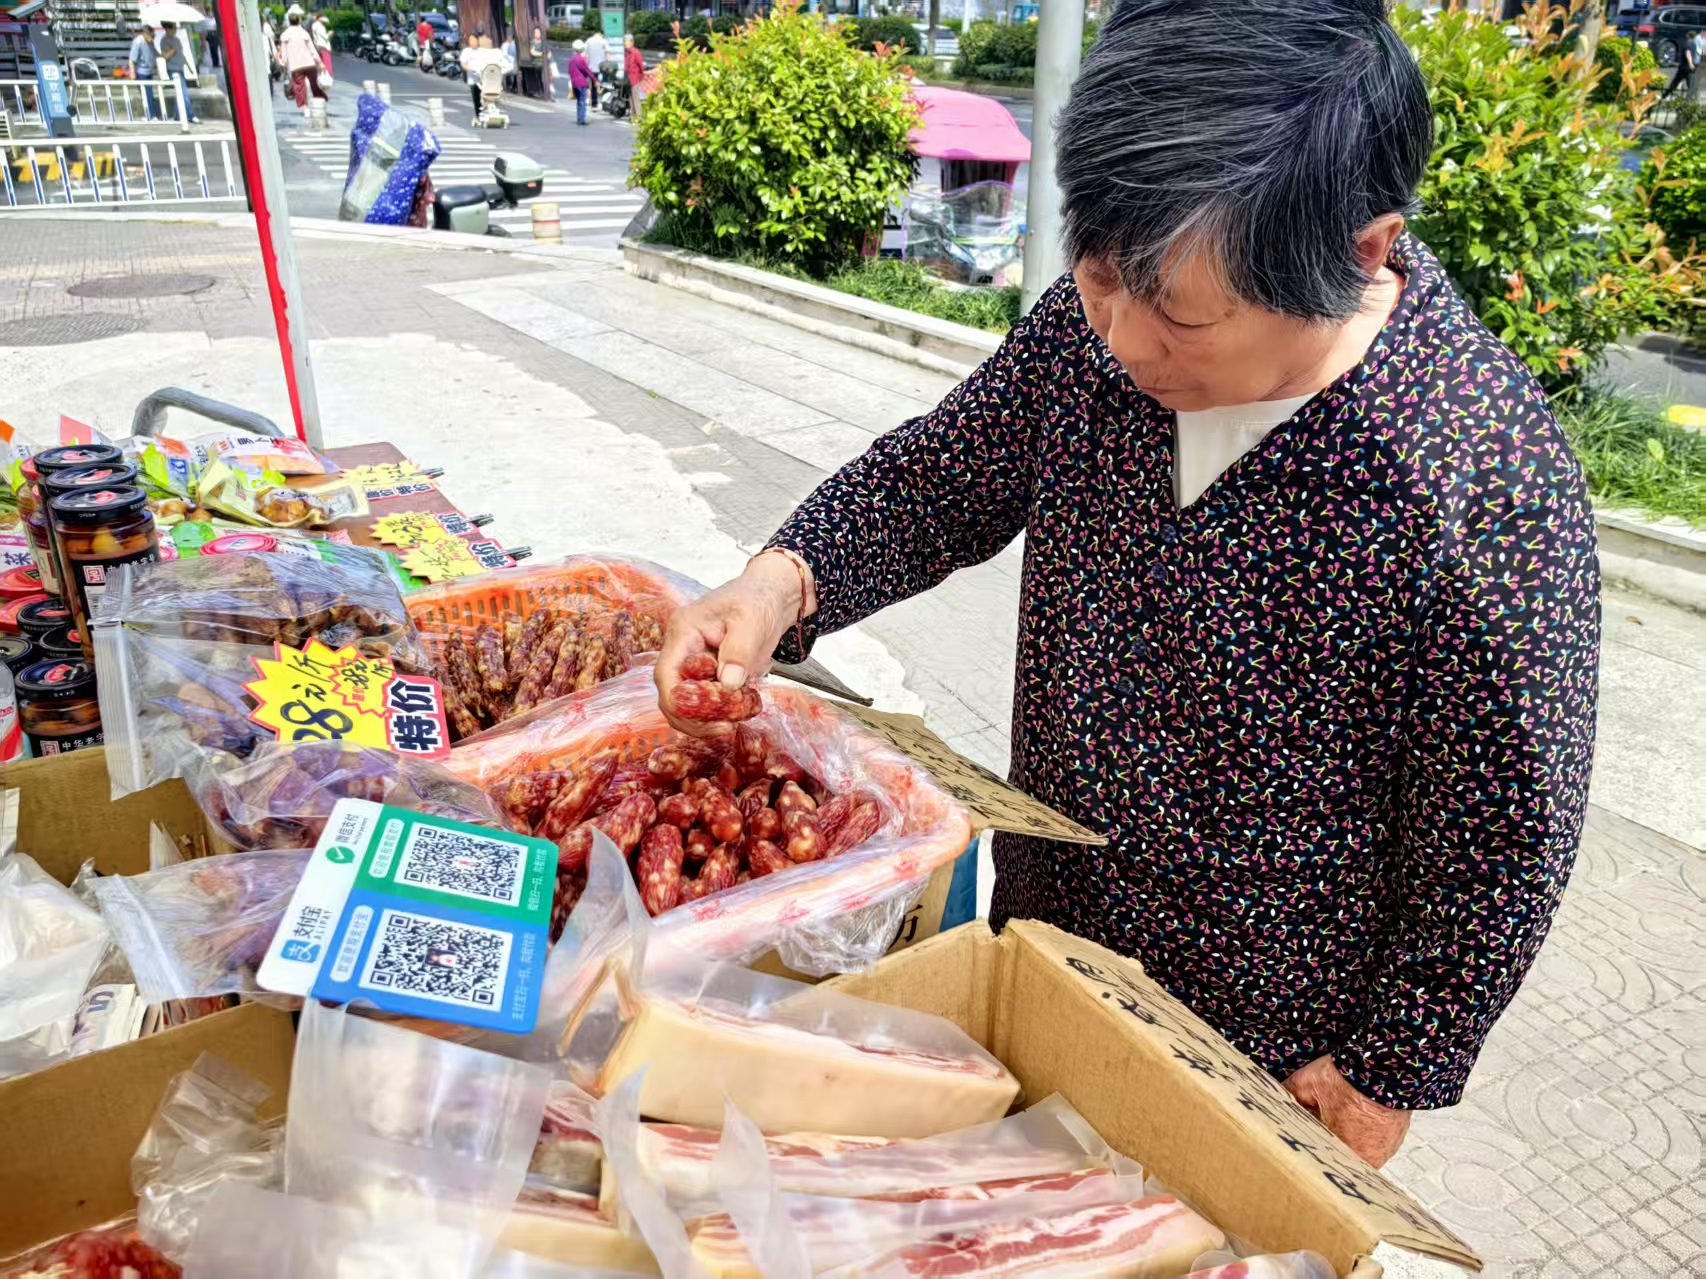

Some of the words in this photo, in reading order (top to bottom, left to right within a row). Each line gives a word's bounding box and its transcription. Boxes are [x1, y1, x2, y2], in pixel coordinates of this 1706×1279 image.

[472, 542, 509, 568] 特价
[390, 680, 439, 751] 特价
[336, 813, 361, 844] 微信支付
[294, 905, 322, 939] 支付宝
[314, 910, 333, 940] ALIPAY
